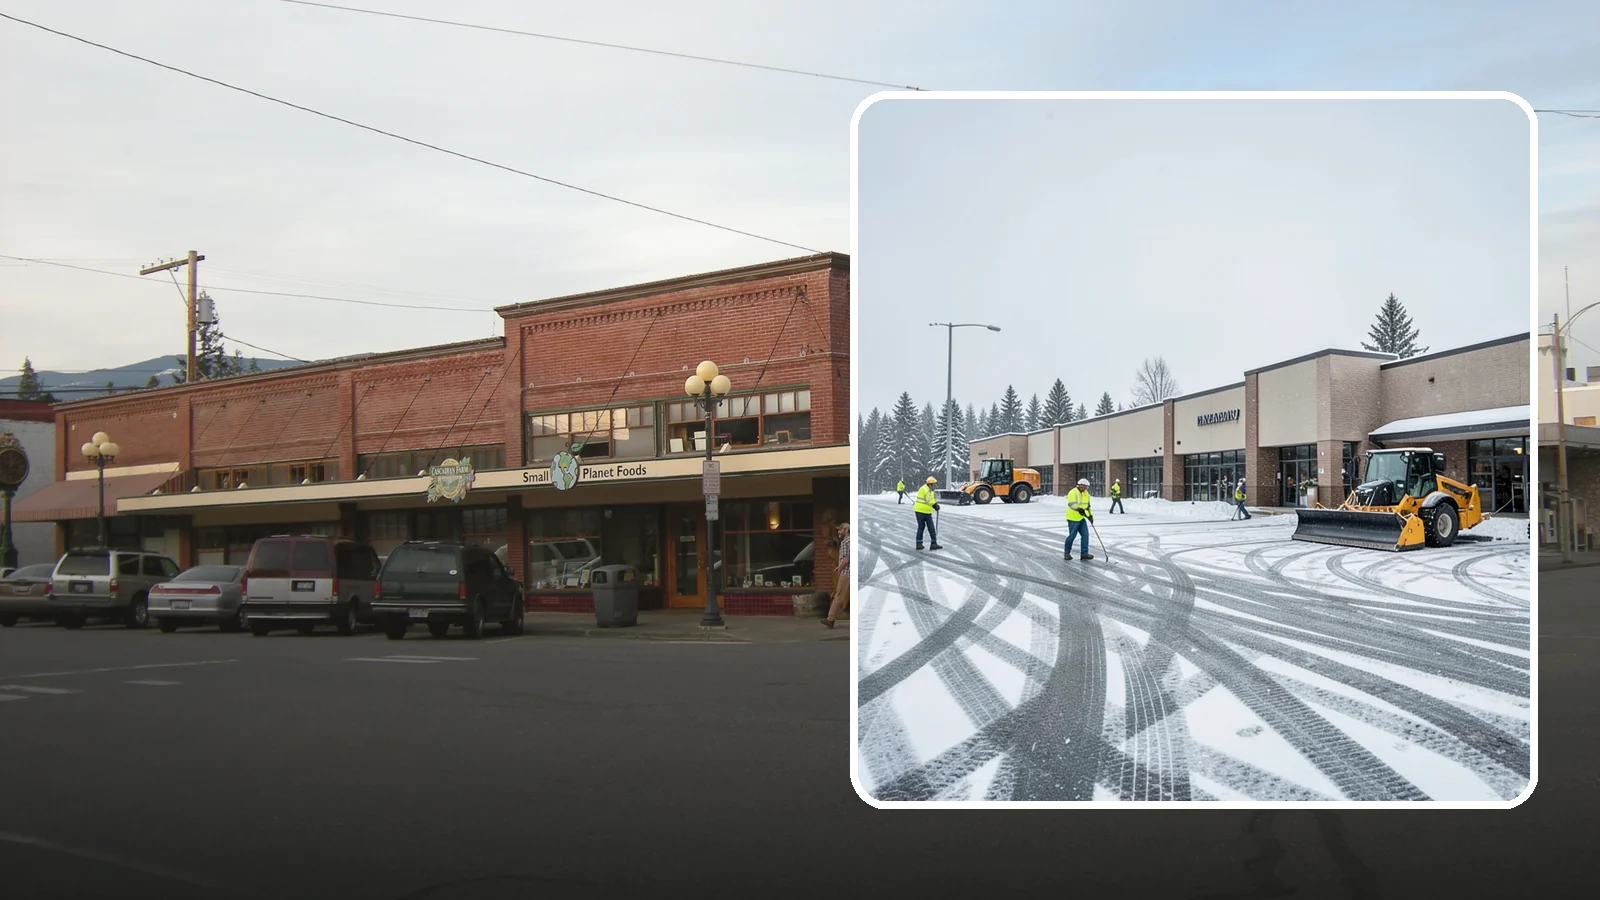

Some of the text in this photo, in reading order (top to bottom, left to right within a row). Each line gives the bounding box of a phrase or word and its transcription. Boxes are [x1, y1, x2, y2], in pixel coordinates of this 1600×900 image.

[431, 466, 469, 476] CASCADIAN FARM
[523, 464, 647, 483] Small Planet Foods
